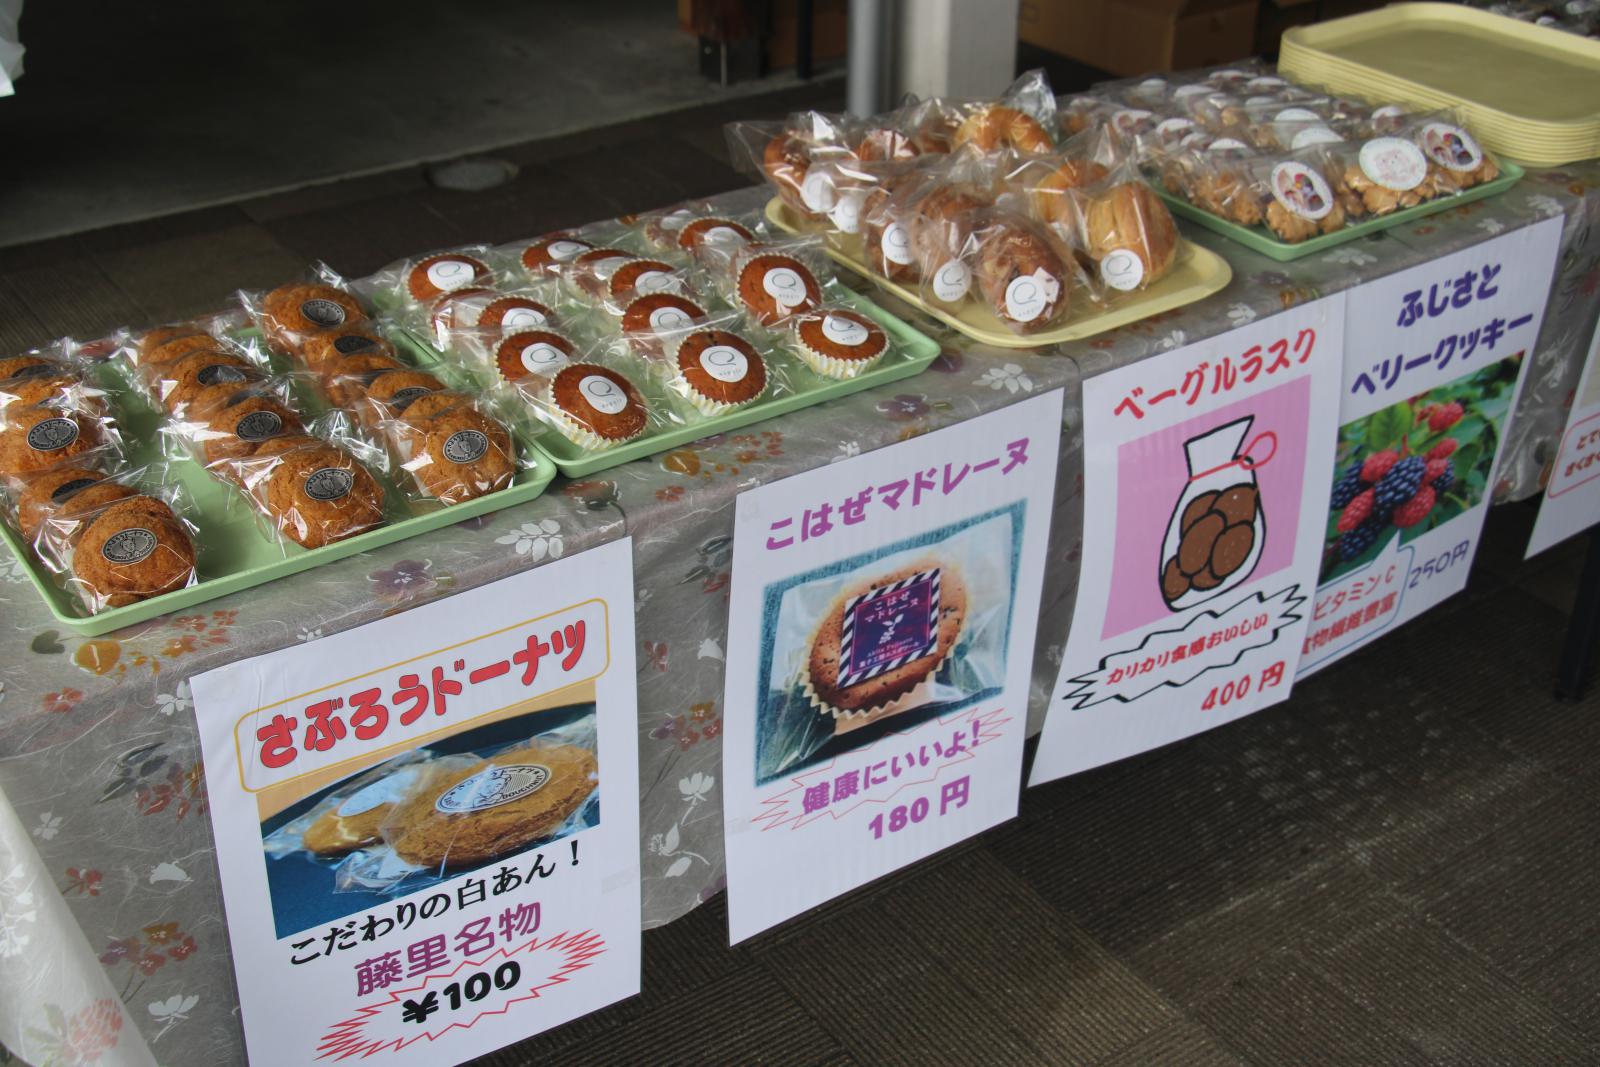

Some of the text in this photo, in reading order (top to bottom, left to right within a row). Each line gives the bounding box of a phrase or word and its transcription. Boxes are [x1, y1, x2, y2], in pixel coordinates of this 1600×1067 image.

[1396, 264, 1502, 328] ふじさと
[1114, 328, 1317, 420] ベーグルラスク
[1351, 313, 1534, 395] ベリークッキー
[766, 437, 1030, 550] こはぜマドレーヌ
[1408, 540, 1470, 590] 250円
[1106, 613, 1268, 686] カリカリ食感おいしい
[1200, 660, 1286, 711] 400 円
[257, 620, 586, 768] さぶろうドーナツ
[802, 719, 981, 815] 健康にいいよ!
[868, 775, 971, 840] 180 円
[290, 839, 580, 965] こだわりの白あん！
[354, 901, 541, 997] 藤里名物
[402, 960, 522, 1024] ¥100
